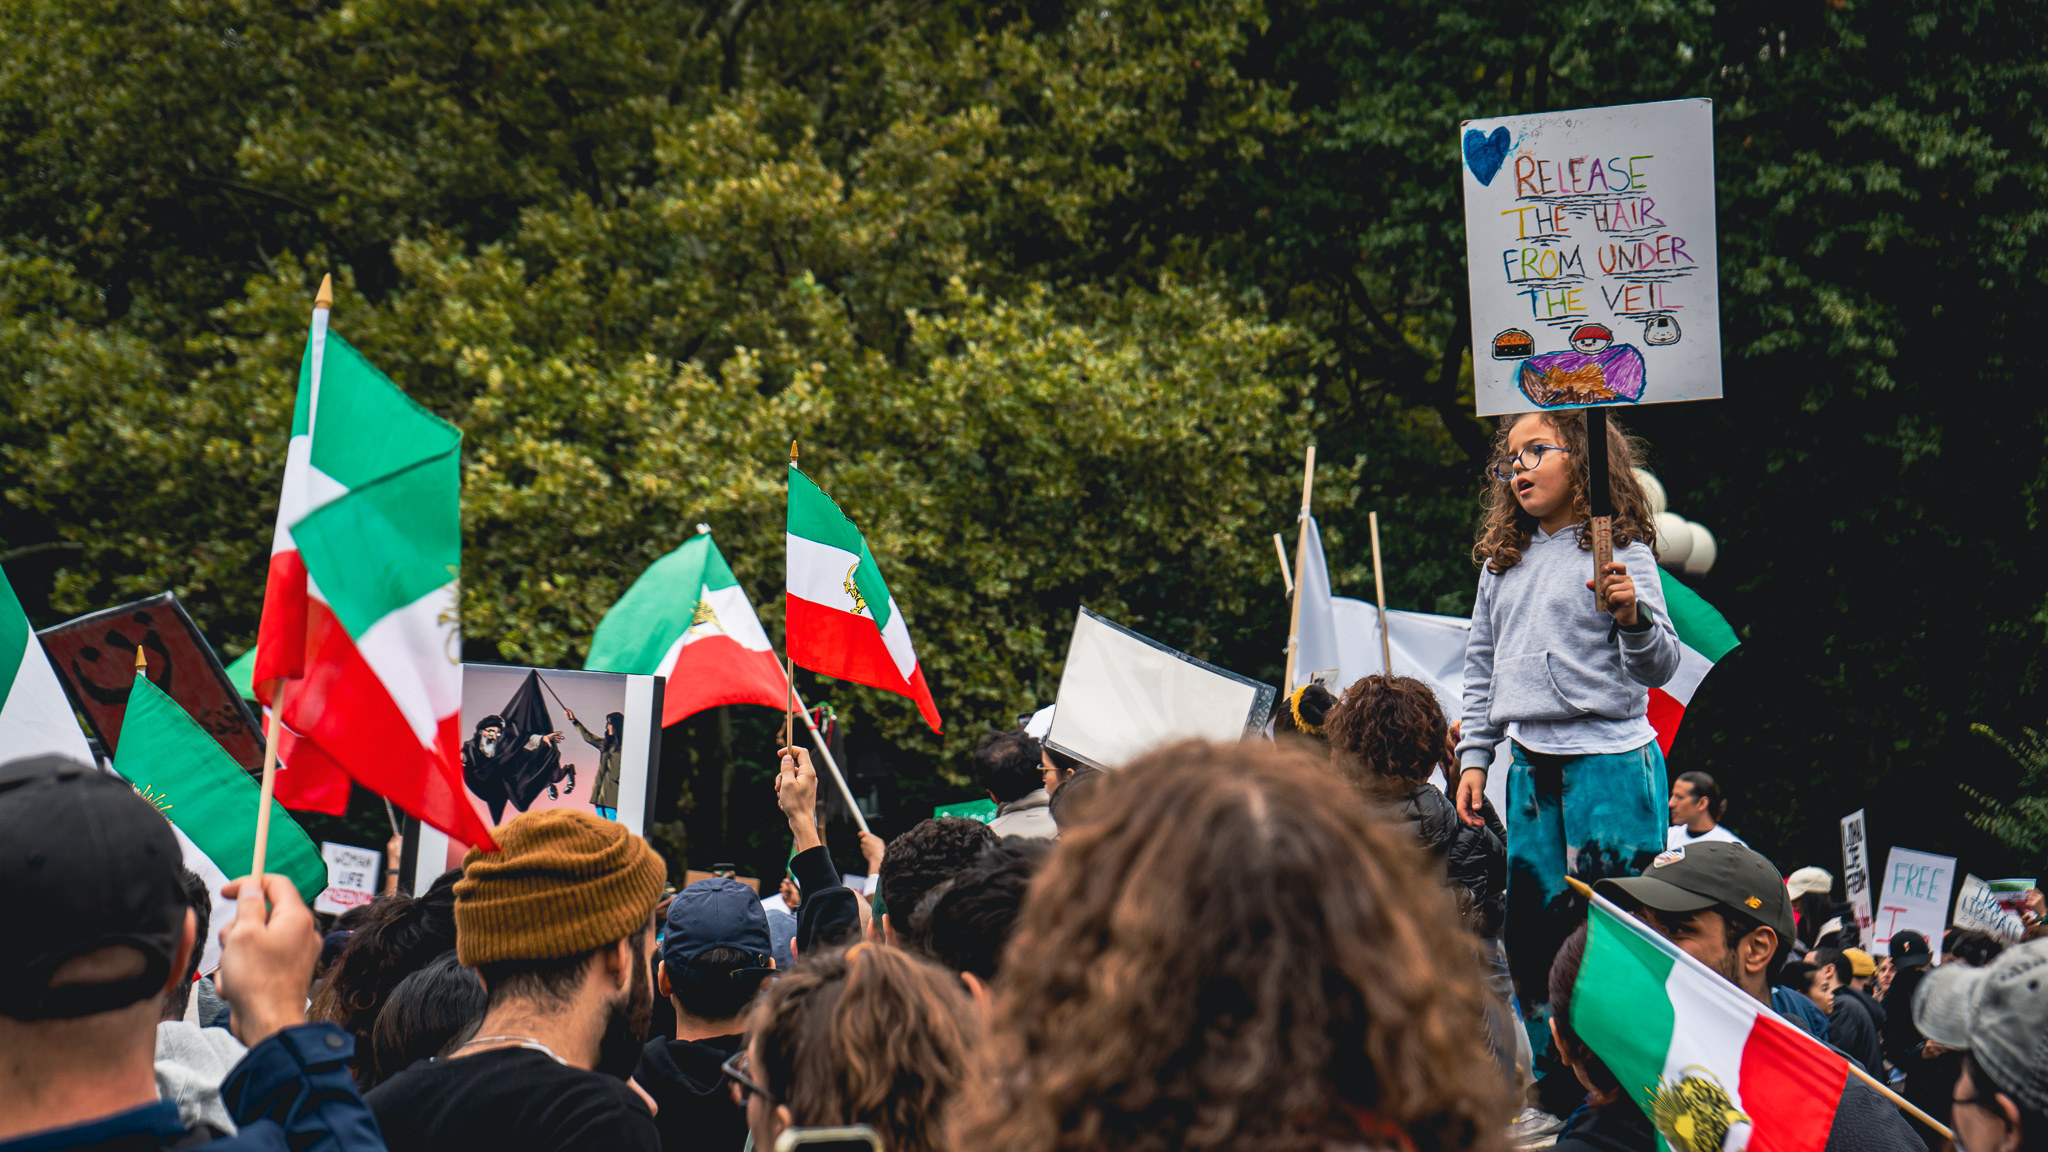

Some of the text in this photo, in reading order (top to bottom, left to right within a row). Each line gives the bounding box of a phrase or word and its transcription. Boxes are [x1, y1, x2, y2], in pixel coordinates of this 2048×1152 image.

[1515, 154, 1653, 198] RELEASE
[1501, 197, 1665, 239] THE HAIR
[1503, 234, 1694, 281] FROM UNDER
[1517, 283, 1683, 317] THE VEIL
[1892, 862, 1945, 903] FREE
